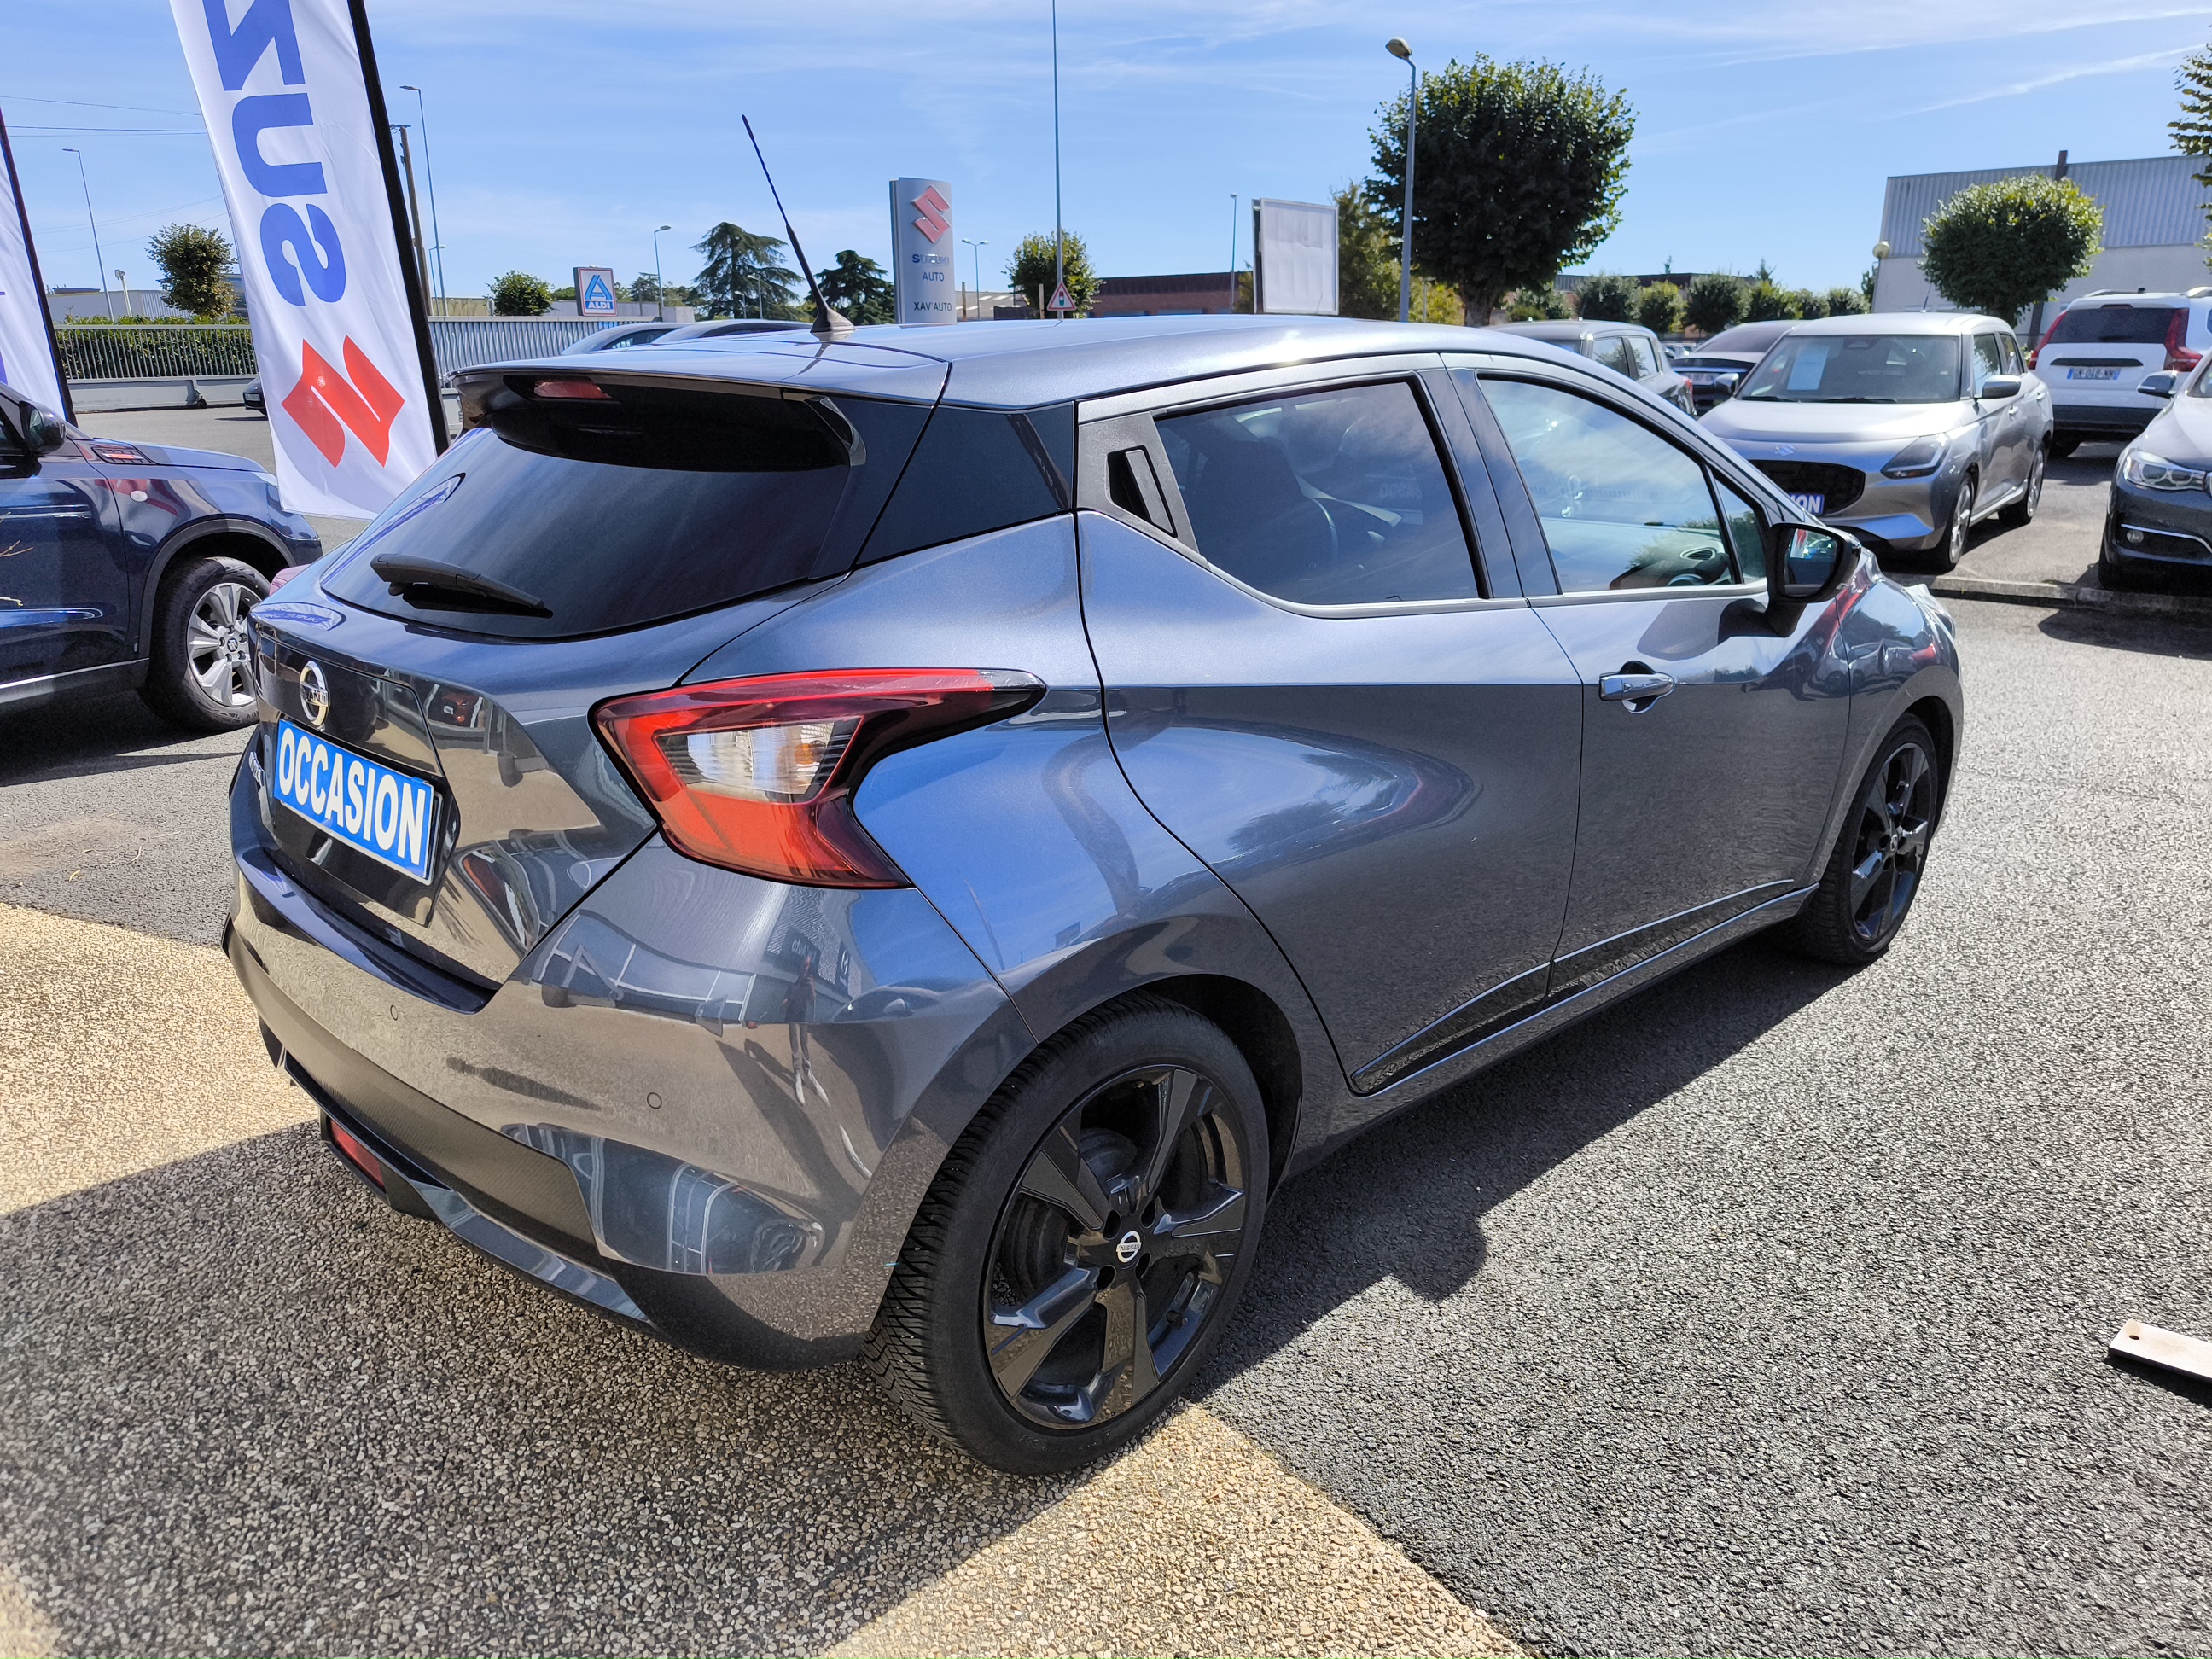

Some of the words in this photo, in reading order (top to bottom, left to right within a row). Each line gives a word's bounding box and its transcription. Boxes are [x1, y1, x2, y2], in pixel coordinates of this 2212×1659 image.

[923, 272, 945, 282] AUTO
[914, 302, 952, 311] XAV'AUTO
[1790, 494, 1821, 513] ON
[279, 728, 426, 865] OCCASION
